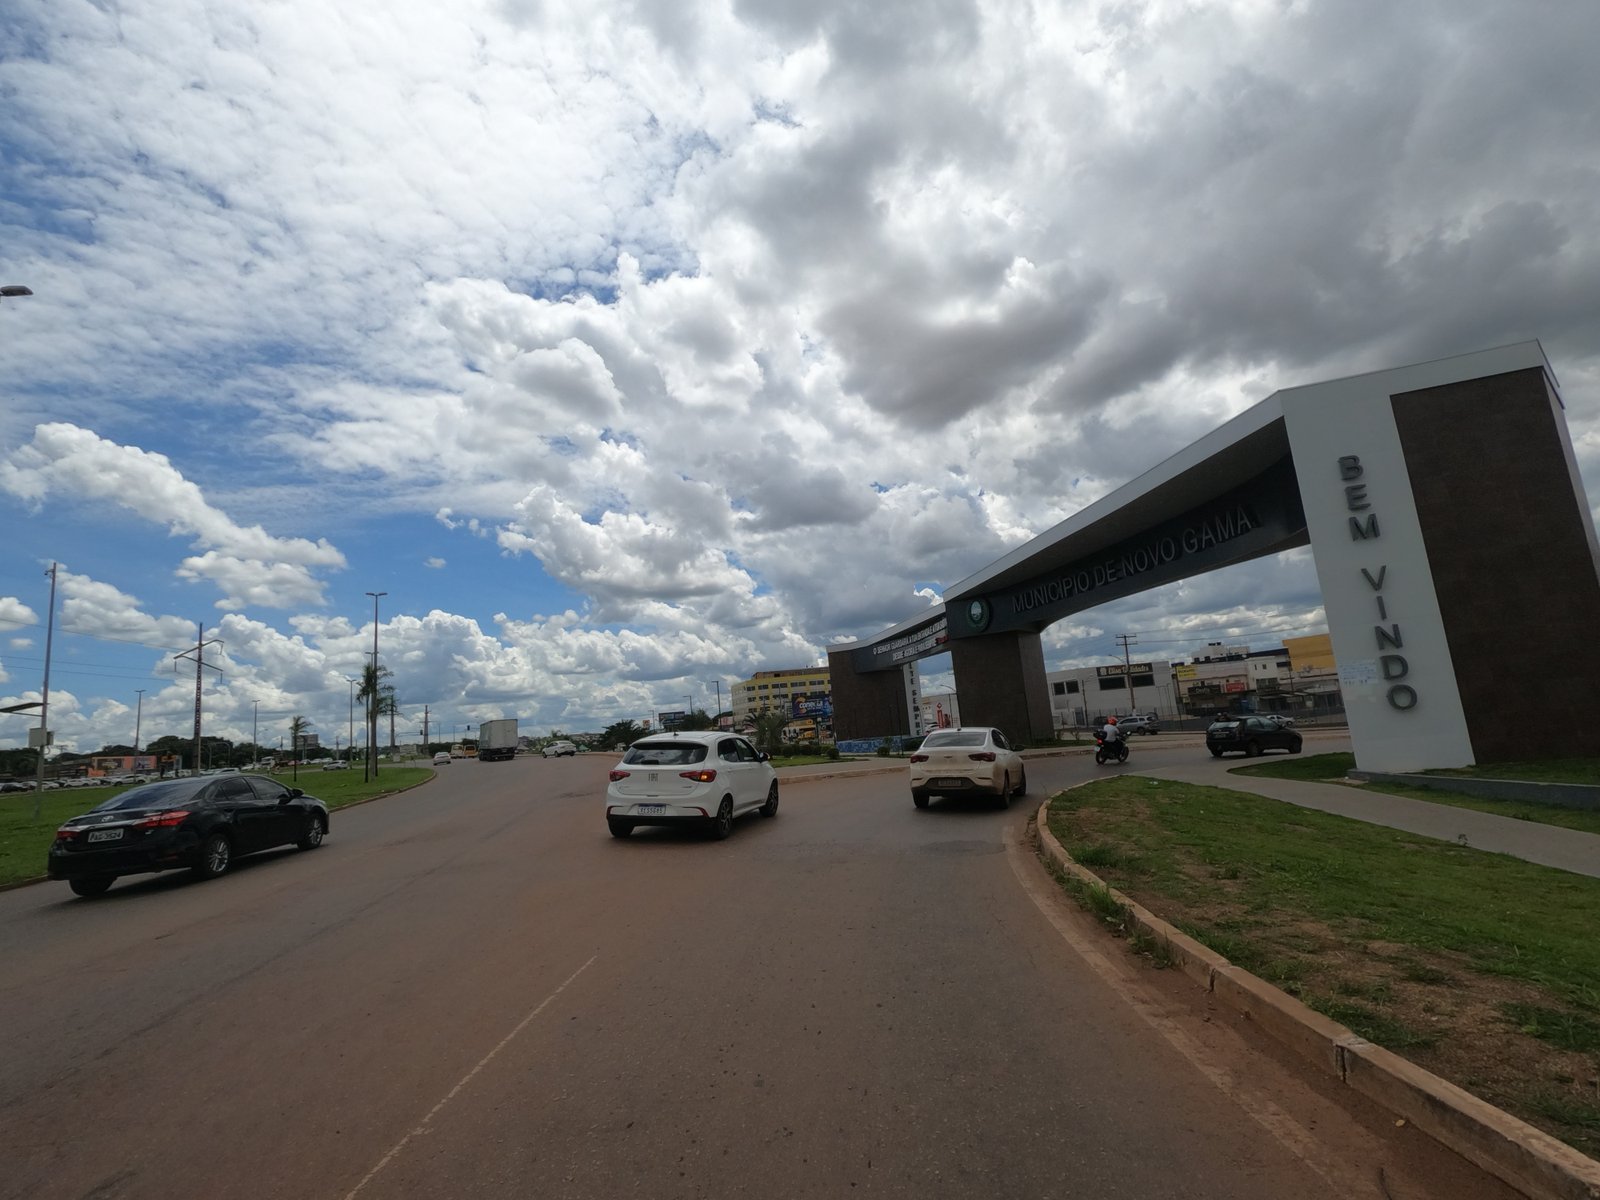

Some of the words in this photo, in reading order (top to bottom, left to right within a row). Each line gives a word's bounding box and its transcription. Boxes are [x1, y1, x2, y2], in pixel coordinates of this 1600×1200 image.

[1093, 560, 1118, 587] DE
[1122, 537, 1175, 577] NOVO
[1182, 505, 1253, 553] GAMA
[1338, 454, 1381, 541] BEM
[1361, 565, 1418, 711] VINDO
